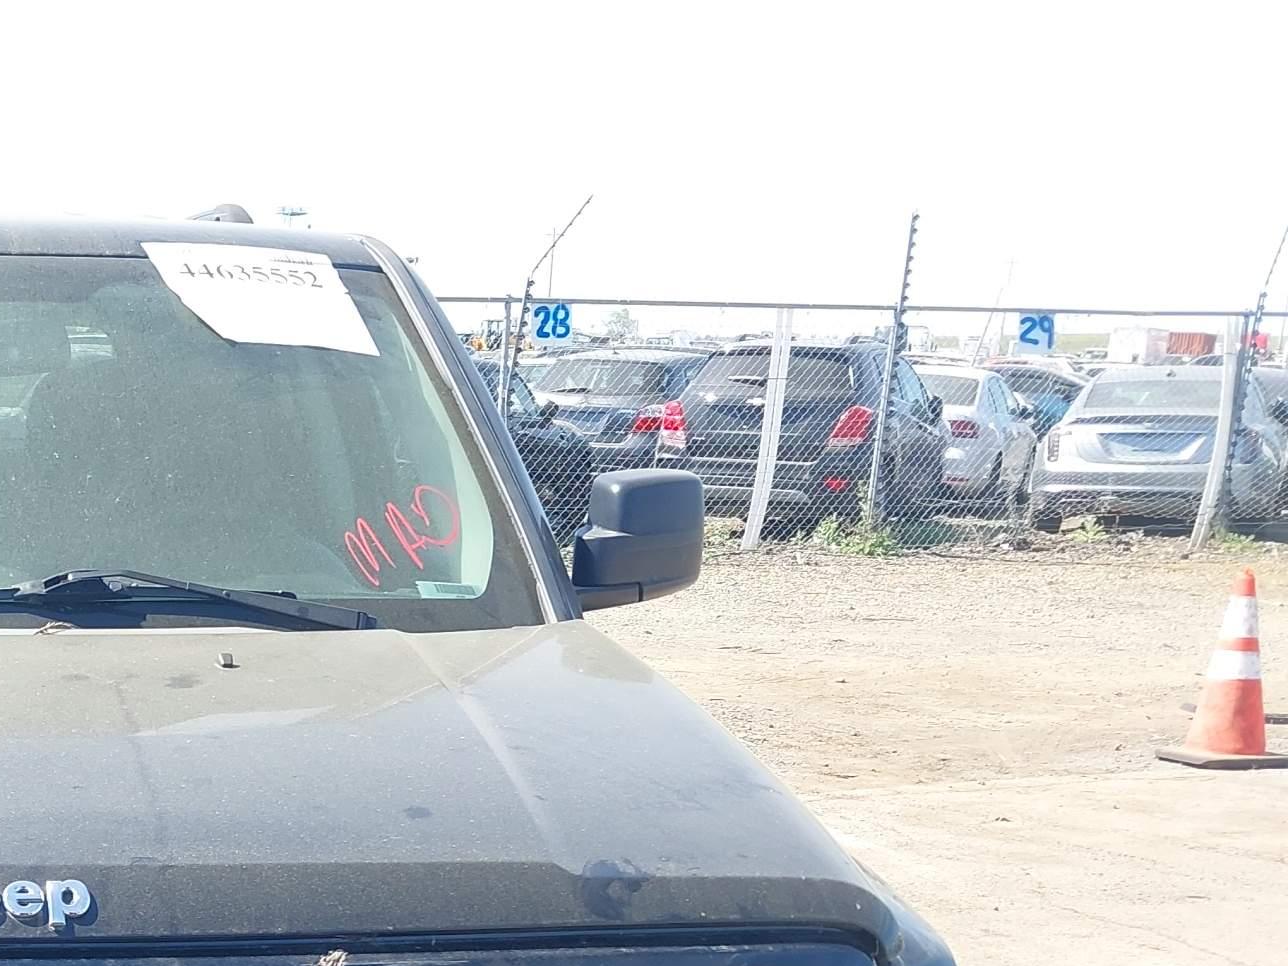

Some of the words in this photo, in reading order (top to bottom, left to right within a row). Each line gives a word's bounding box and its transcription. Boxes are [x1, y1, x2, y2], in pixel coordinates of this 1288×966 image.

[179, 262, 324, 289] 44635552
[534, 303, 571, 339] 28
[1020, 315, 1055, 349] 29
